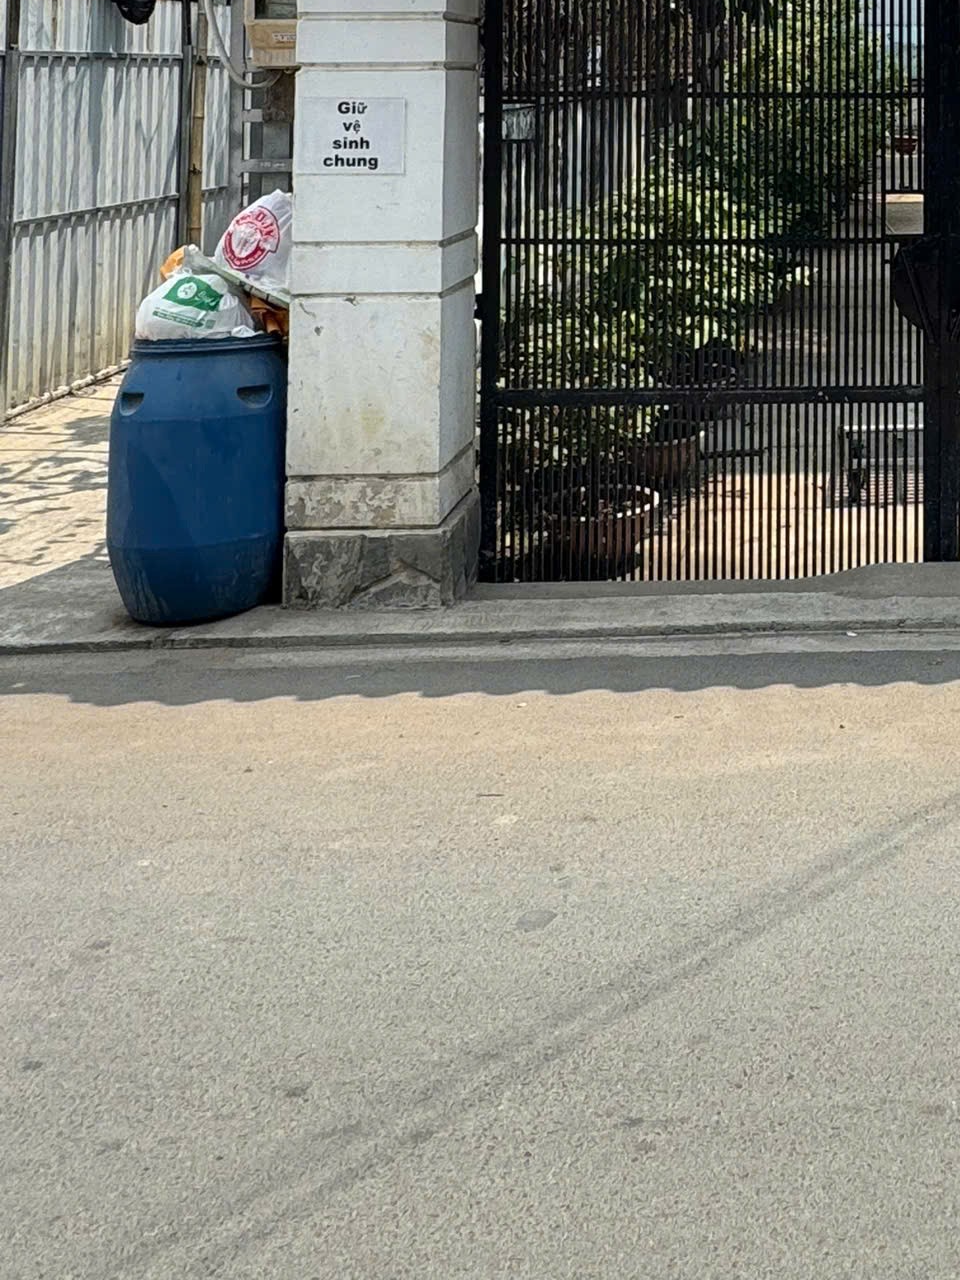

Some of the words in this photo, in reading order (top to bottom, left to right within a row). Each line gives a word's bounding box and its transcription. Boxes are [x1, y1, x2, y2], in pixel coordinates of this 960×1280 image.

[337, 101, 368, 114] Giữ
[342, 119, 361, 134] vệ
[332, 136, 370, 149] sinh
[323, 154, 379, 170] chung
